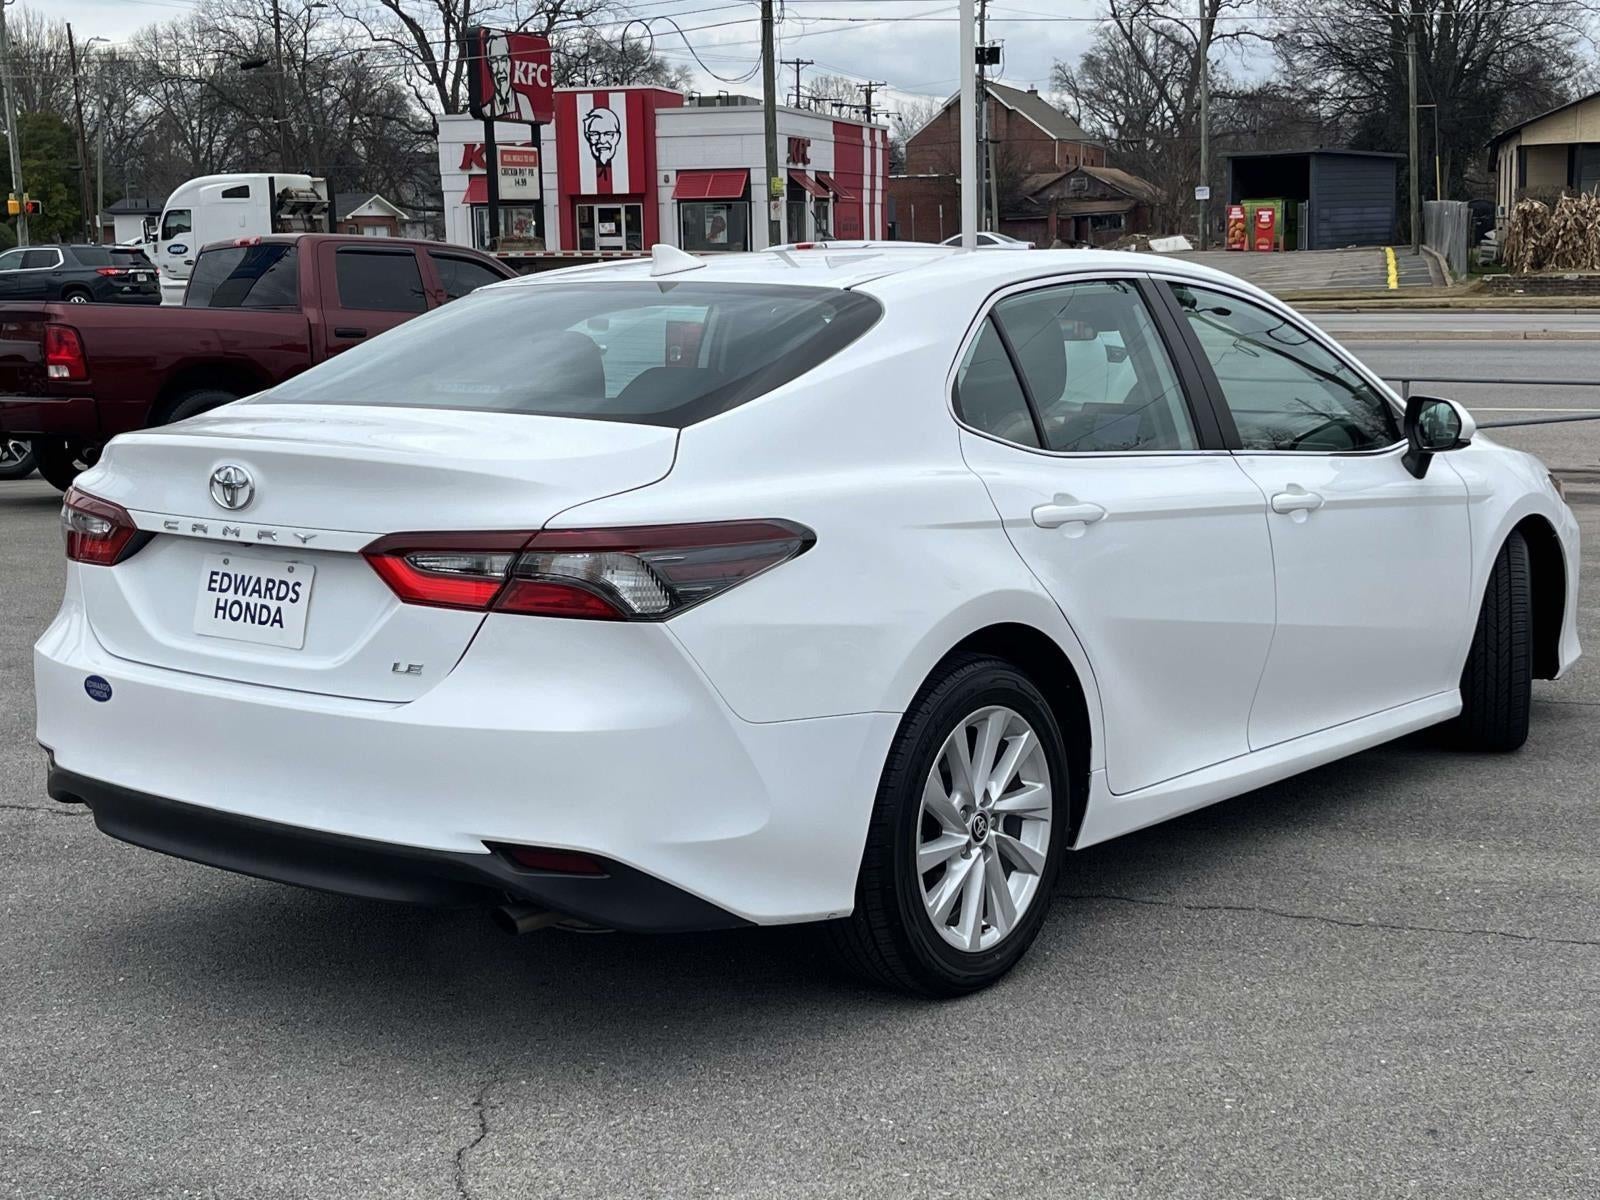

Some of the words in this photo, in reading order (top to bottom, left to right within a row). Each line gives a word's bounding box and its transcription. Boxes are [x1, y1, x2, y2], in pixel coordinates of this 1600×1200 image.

[513, 61, 548, 87] KFC
[501, 168, 518, 176] CHICKEN
[519, 168, 527, 177] POT
[163, 520, 317, 544] CAMRY
[207, 570, 302, 604] EDWARDS
[214, 597, 284, 629] HONDA
[391, 662, 424, 675] LE
